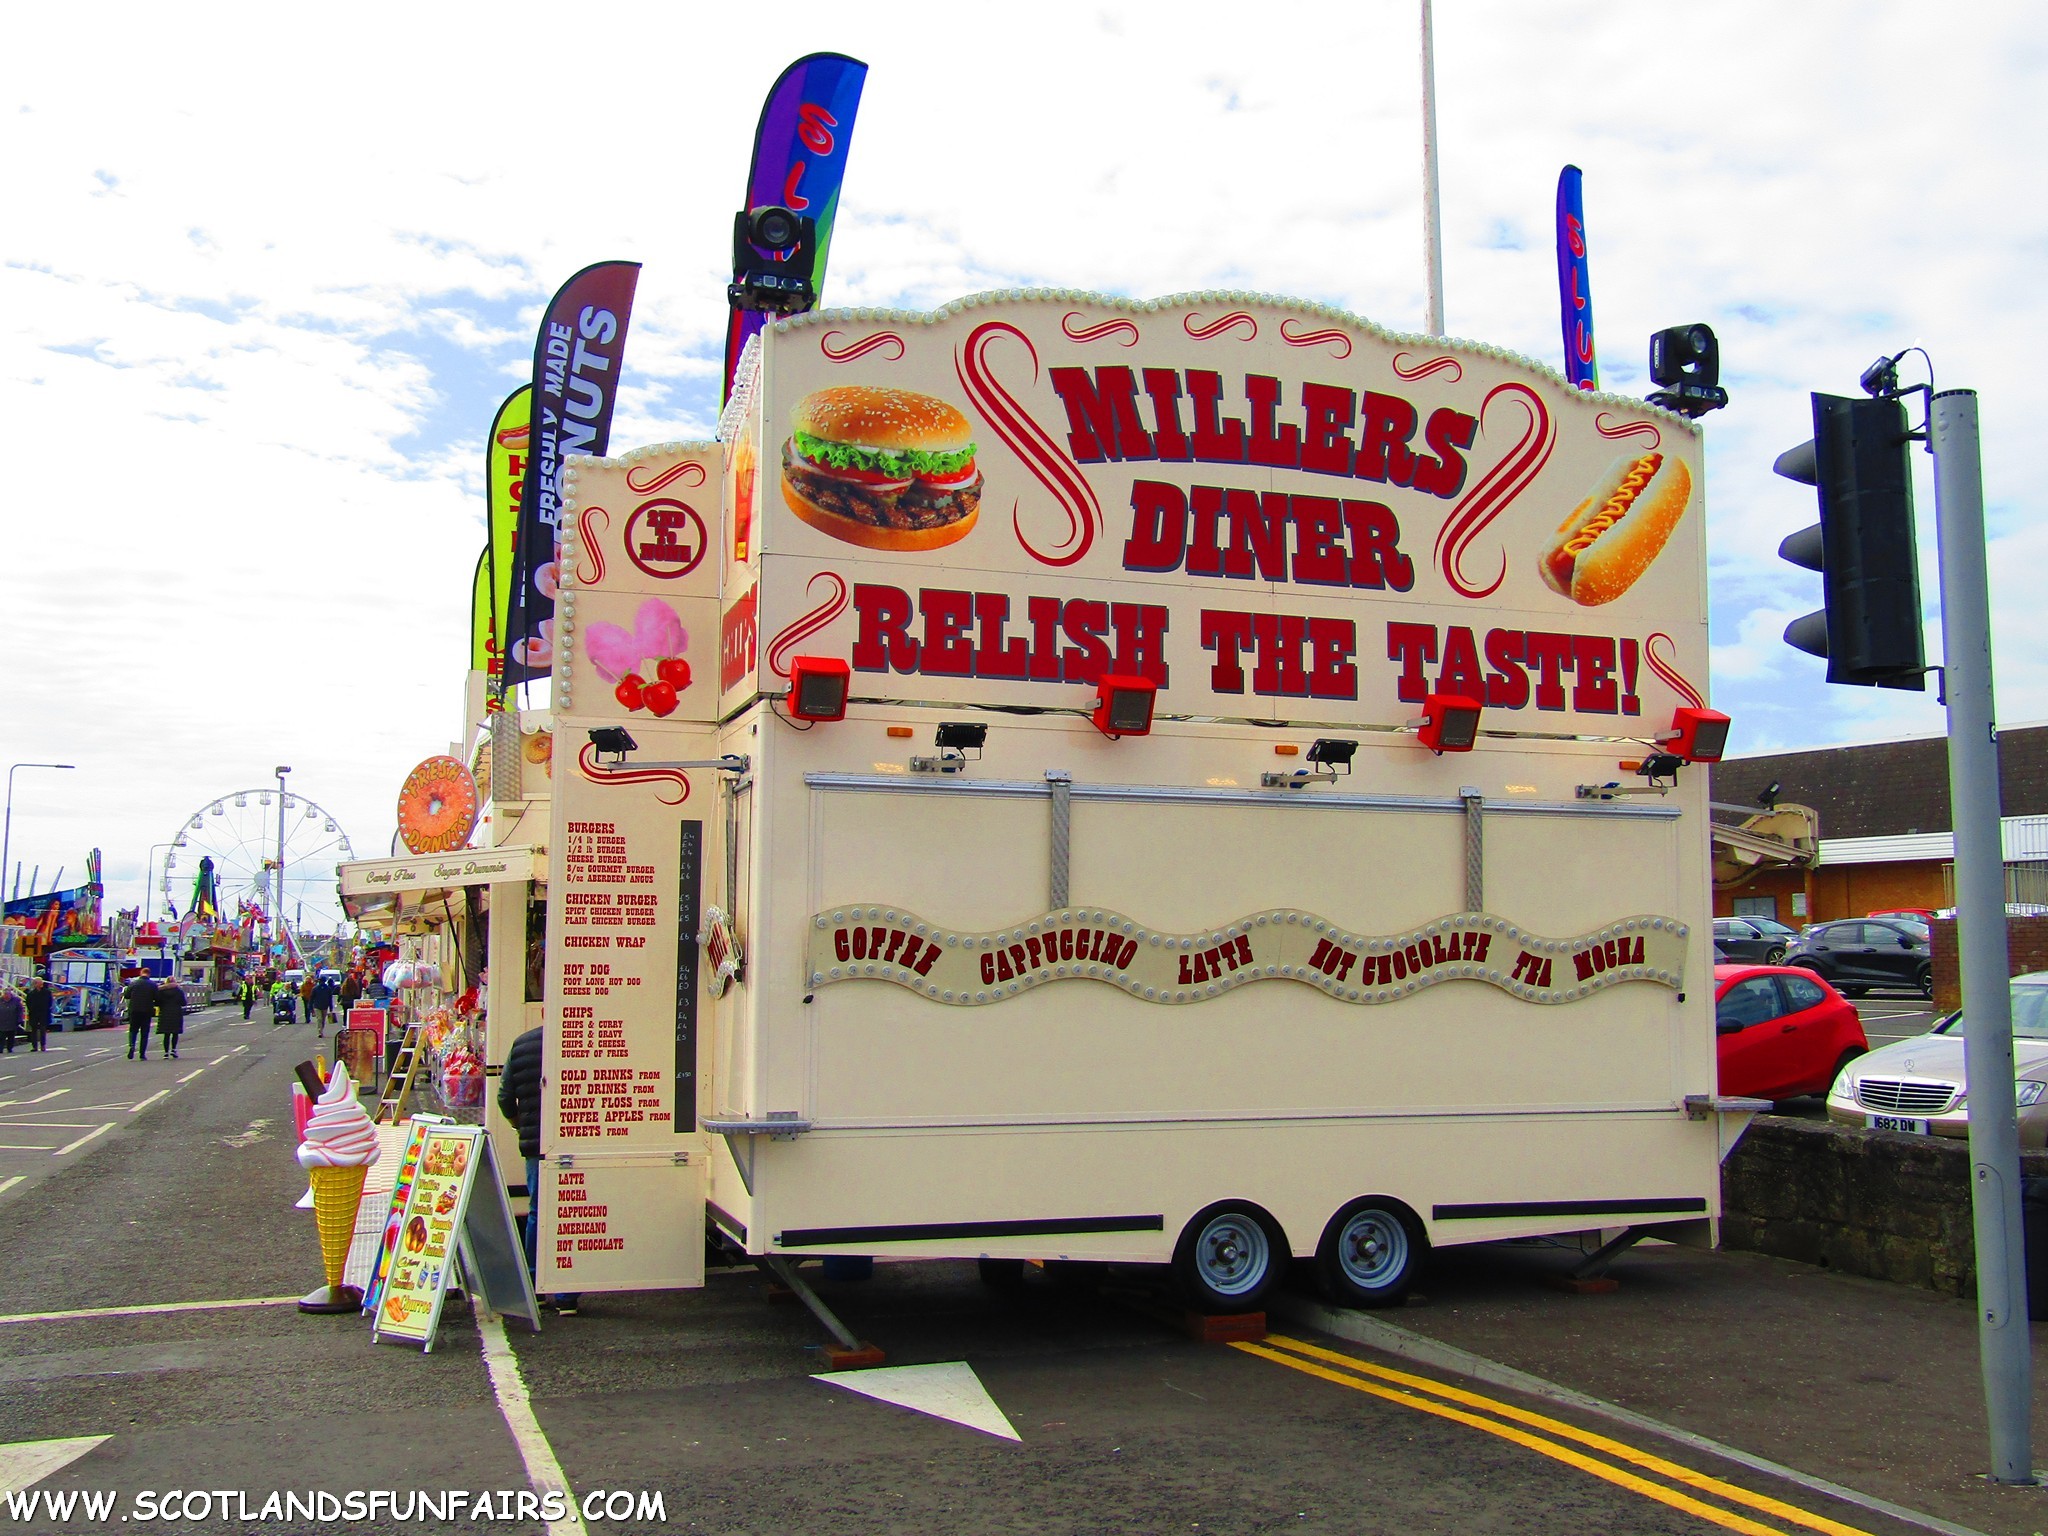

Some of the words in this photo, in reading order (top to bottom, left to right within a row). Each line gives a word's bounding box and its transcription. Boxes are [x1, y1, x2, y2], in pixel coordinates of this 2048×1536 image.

[544, 321, 572, 398] MADE
[1048, 364, 1479, 499] MILLERS
[647, 509, 686, 528] 2ND
[1122, 479, 1415, 592] DINER
[640, 543, 692, 563] NONE
[852, 582, 1169, 688] RELISH
[1201, 609, 1358, 701] THE
[1387, 621, 1641, 716] TASTE!
[407, 760, 463, 799] FRESH
[407, 811, 469, 853] DONUTS
[568, 822, 614, 834] BURGERS
[597, 836, 625, 844] BURGER
[568, 845, 582, 854] 1/2
[597, 846, 625, 854] BURGER
[567, 855, 594, 863] CHEESE
[366, 871, 391, 885] Candy
[393, 868, 416, 881] Floss
[434, 863, 461, 880] Sugar
[463, 861, 507, 875] Dummies
[588, 865, 622, 873] GOURMET
[627, 866, 655, 874] BURGER
[588, 875, 626, 883] ABERDEEN
[566, 894, 611, 905] CHICKEN
[617, 895, 657, 905] BURGER
[566, 907, 586, 915] SPICY
[590, 907, 621, 915] CHICKEN
[626, 908, 654, 916] BURGER
[592, 917, 623, 925] CHICKEN
[565, 936, 610, 947] CHICKEN
[616, 937, 645, 947] WRAP
[834, 927, 943, 977] COFFEE
[980, 929, 1139, 985] CAPPUCCINO
[1178, 934, 1254, 985] LATTE
[1308, 938, 1358, 982] HOT
[1362, 932, 1492, 986] CHOCOLATE
[1511, 951, 1553, 987] TEA
[1572, 936, 1646, 982] MOCHA
[564, 964, 584, 975] HOT
[591, 964, 610, 975] DOG
[564, 987, 590, 995] CHEESE
[595, 987, 609, 995] DOG
[563, 1007, 593, 1018] CHIPS
[599, 1020, 623, 1028] CURRY
[588, 1030, 594, 1038] &
[599, 1030, 622, 1038] GRAVY
[562, 1040, 583, 1048] CHIPS
[588, 1040, 593, 1048] &
[598, 1040, 625, 1048] CHEESE
[562, 1050, 590, 1058] BUCKET
[607, 1049, 628, 1057] FRIES
[562, 1070, 587, 1081] COLD
[594, 1069, 633, 1080] DRINKS
[561, 1084, 581, 1095] HOT
[588, 1083, 627, 1094] DRINKS
[633, 1085, 654, 1093] FROM
[561, 1098, 595, 1109] CANDY
[602, 1097, 632, 1108] FLOSS
[638, 1099, 659, 1107] FROM
[560, 1112, 598, 1123] TOFFEE
[605, 1110, 643, 1122] APPLES
[560, 1125, 601, 1137] SWEETS
[607, 1128, 628, 1136] FROM
[1900, 1119, 1915, 1132] DW
[559, 1173, 584, 1185] LATTE
[559, 1190, 587, 1201] MOCHA
[558, 1206, 607, 1218] CAPPUCCINO
[558, 1222, 606, 1235] AMERICANO
[557, 1240, 573, 1251] HOT
[578, 1238, 623, 1250] CHOCOLATE
[556, 1257, 572, 1268] TEA
[401, 1295, 432, 1315] Churros
